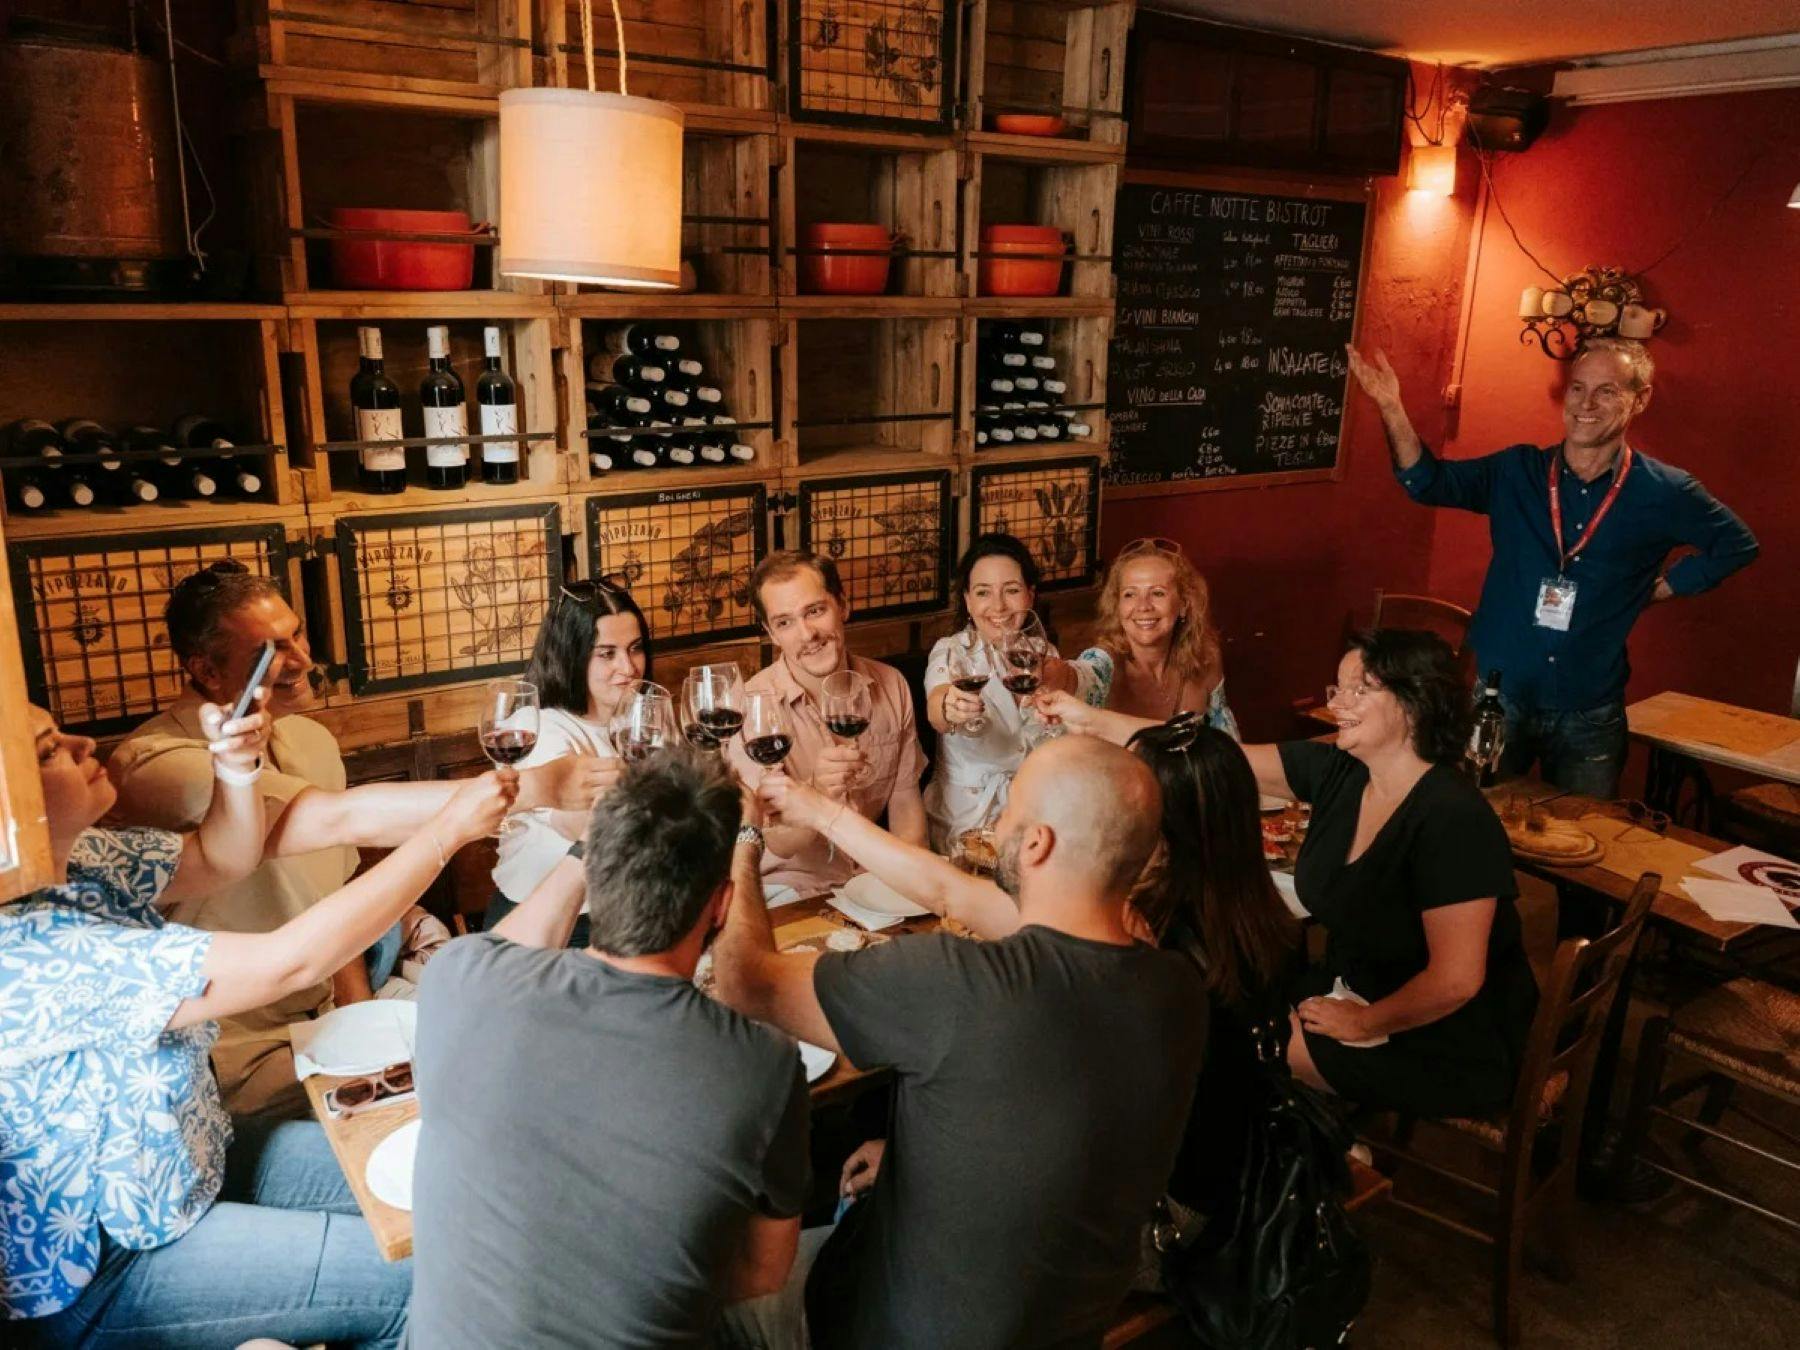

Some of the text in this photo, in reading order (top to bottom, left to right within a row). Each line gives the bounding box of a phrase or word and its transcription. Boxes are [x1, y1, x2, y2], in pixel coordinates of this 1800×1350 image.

[1209, 197, 1260, 222] NOTTE
[1266, 199, 1333, 228] BISTROT
[1290, 232, 1340, 250] TAGLIERI
[1134, 307, 1157, 327] VINI
[1161, 308, 1199, 326] BIANCHI
[1267, 345, 1330, 376] INSALATE
[1127, 385, 1155, 405] VINO
